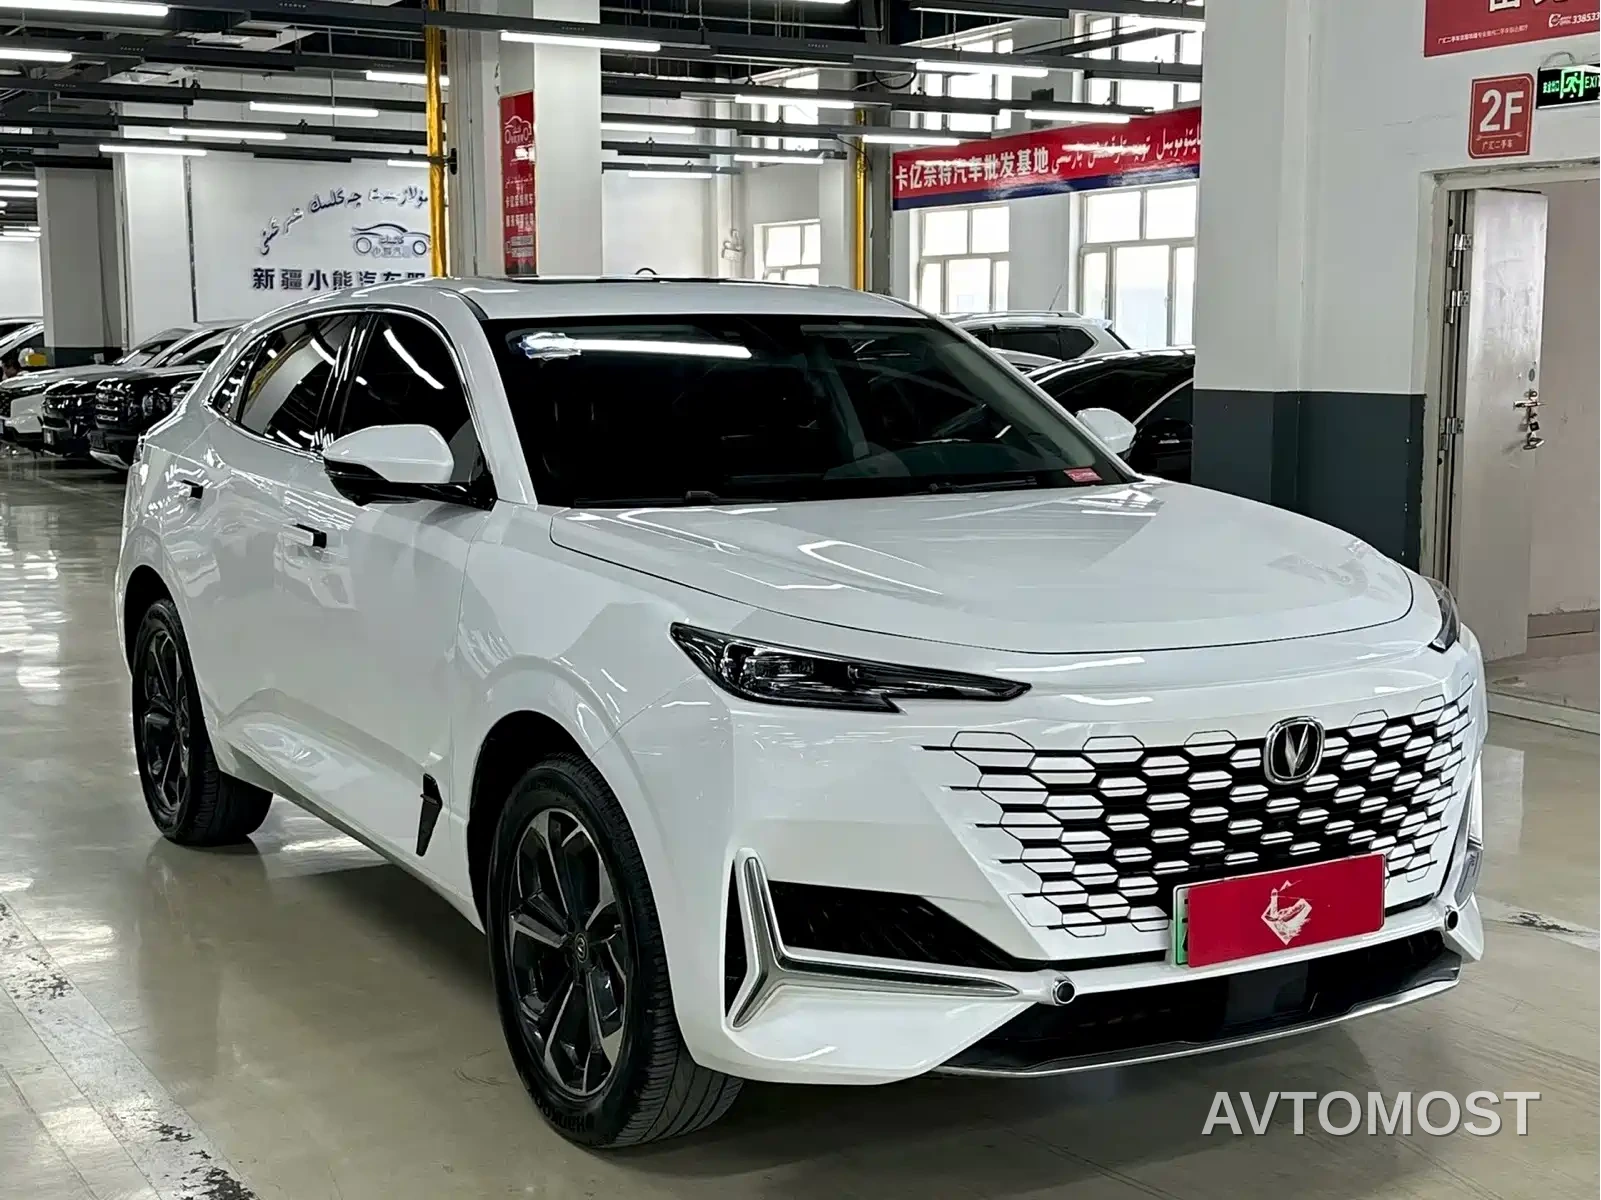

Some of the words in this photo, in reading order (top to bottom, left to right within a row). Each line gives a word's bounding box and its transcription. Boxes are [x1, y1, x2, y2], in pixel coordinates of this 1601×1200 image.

[1480, 89, 1525, 133] 2F
[895, 146, 1049, 191] 卡亿奈特汽车批发基地
[252, 267, 426, 290] 新疆小熊汽
